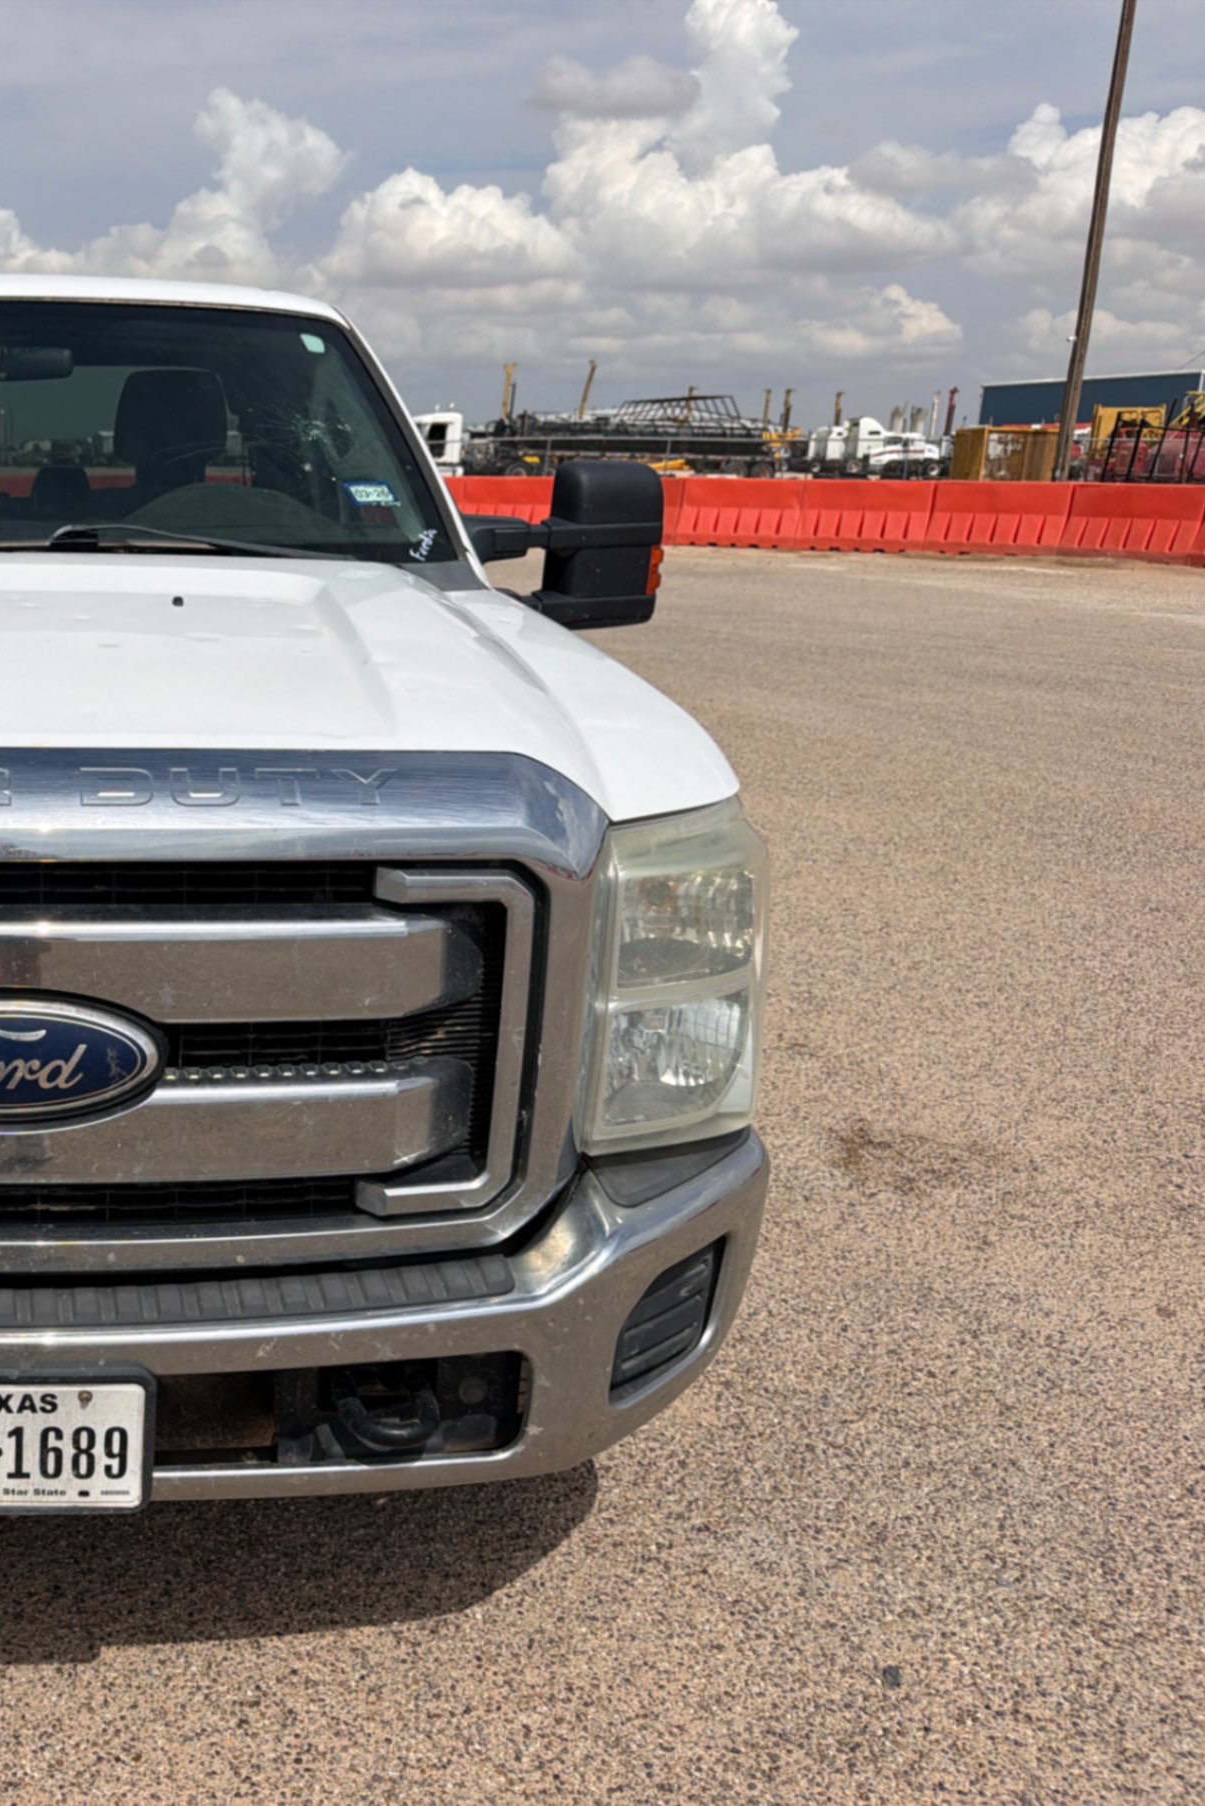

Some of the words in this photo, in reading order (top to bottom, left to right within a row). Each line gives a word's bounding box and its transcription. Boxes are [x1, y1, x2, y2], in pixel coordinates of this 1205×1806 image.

[80, 767, 395, 807] DUTY
[6, 1426, 128, 1480] 1689
[3, 1488, 28, 1496] Star
[33, 1488, 67, 1496] State
